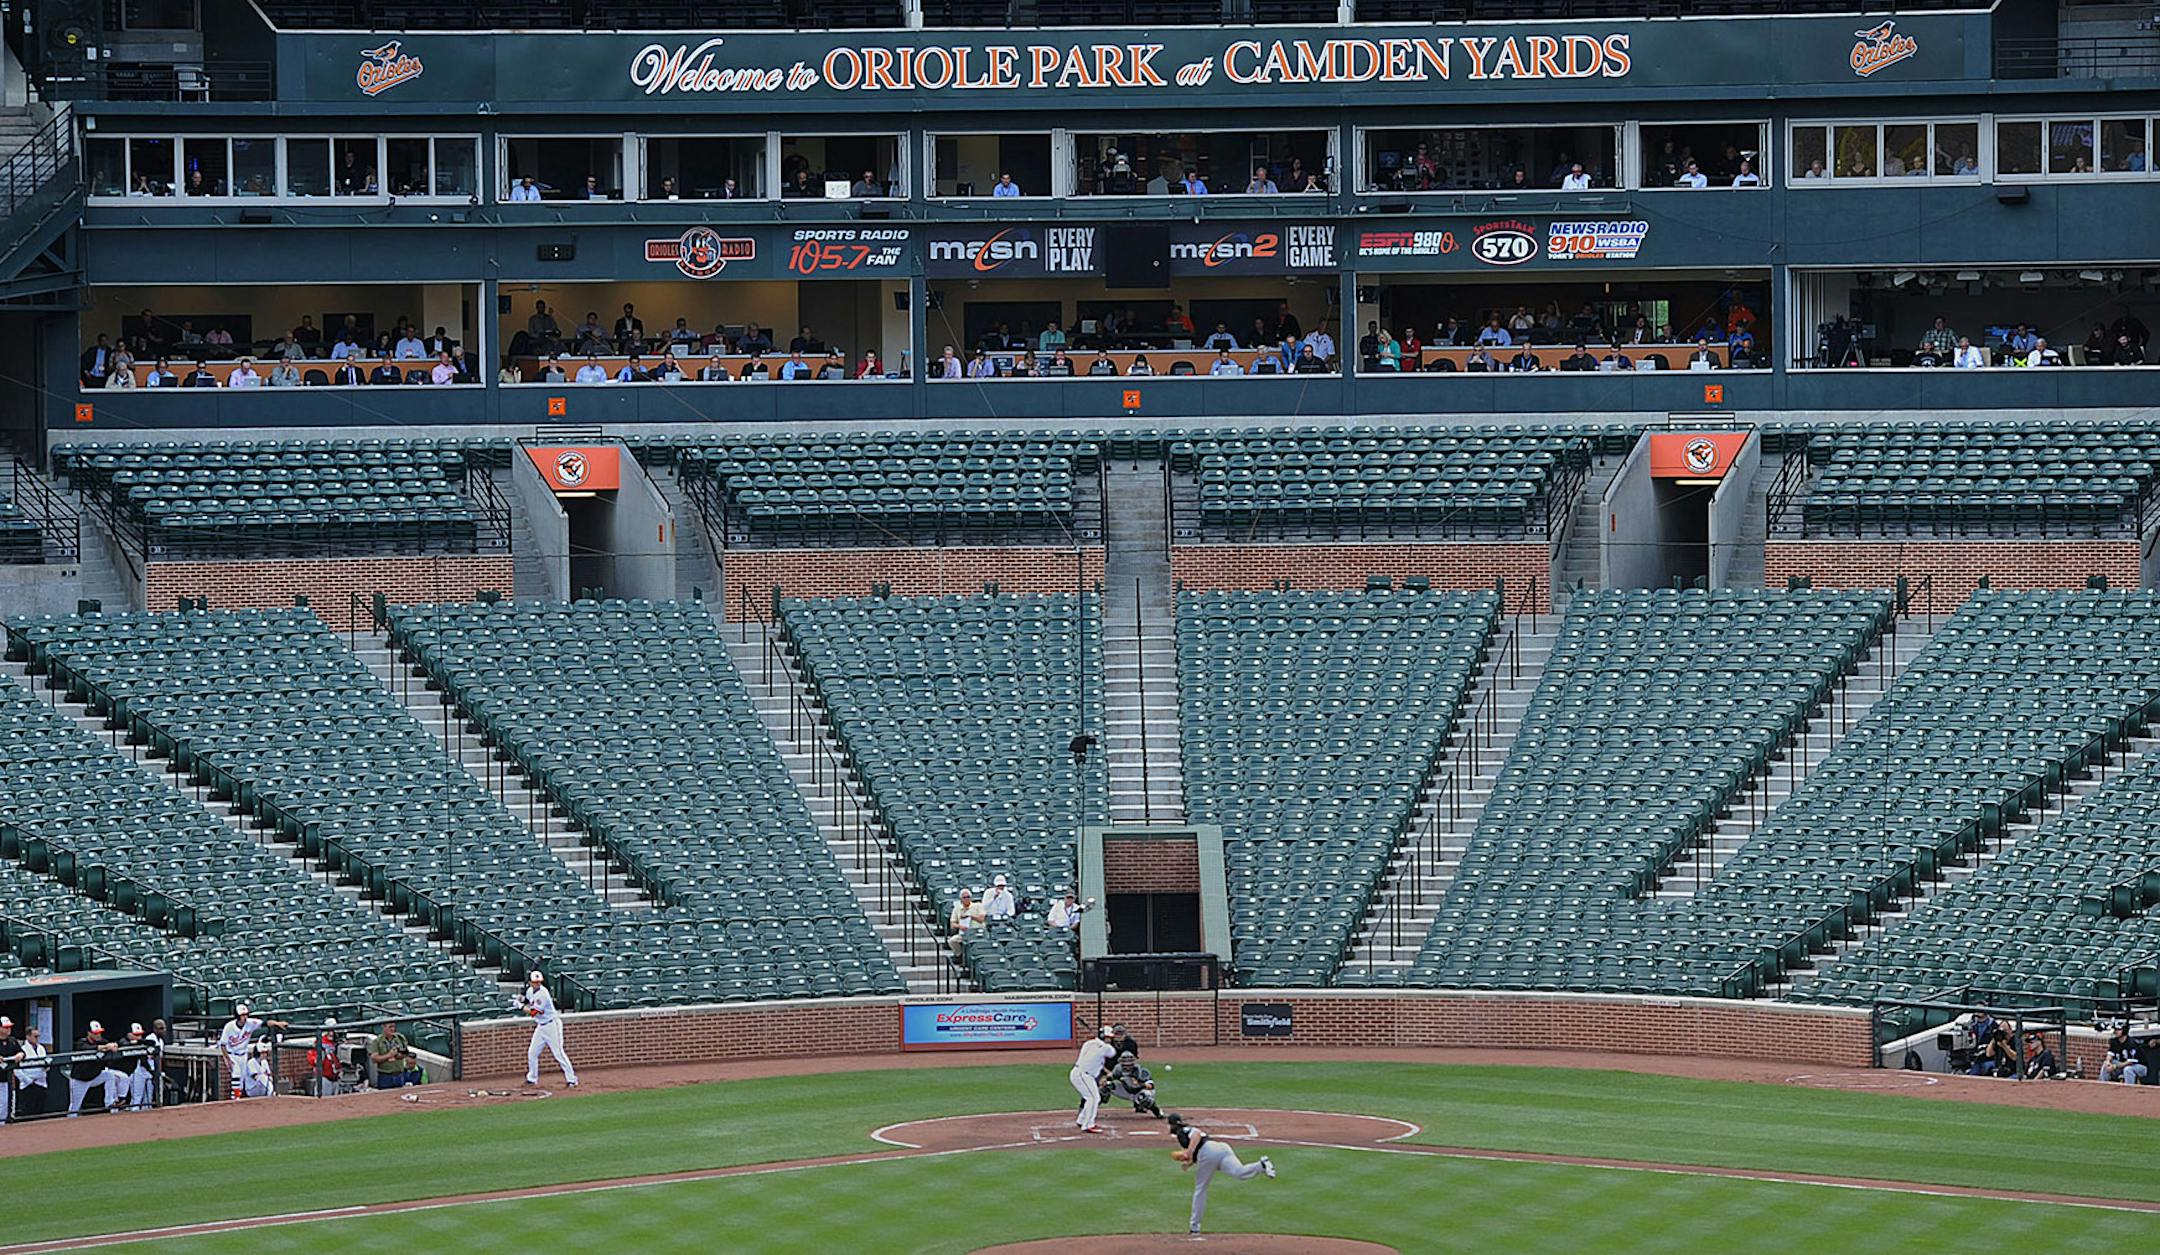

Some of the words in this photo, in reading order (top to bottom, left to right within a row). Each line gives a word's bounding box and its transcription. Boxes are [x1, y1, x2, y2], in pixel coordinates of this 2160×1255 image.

[1850, 33, 1918, 70] Orioles
[357, 54, 424, 91] Orioles
[630, 38, 784, 95] Welcome
[786, 61, 820, 91] to
[822, 45, 1020, 90] ORIOLE
[1028, 44, 1168, 87] PARK
[1175, 56, 1214, 87] at
[1223, 37, 1453, 84] CAMDEN
[1460, 34, 1631, 80] YARDS
[793, 230, 856, 241] SPORTS
[860, 229, 910, 240] RADIO
[1048, 228, 1096, 247] EVERY
[1289, 226, 1337, 246] EVERY
[1550, 222, 1648, 236] NEWSRADIO
[649, 244, 680, 257] ORIOLES
[722, 240, 751, 256] RADIO
[1360, 232, 1414, 248] ESPN
[1413, 231, 1443, 247] 980
[1481, 236, 1530, 259] 570
[1549, 235, 1596, 253] 910
[1596, 237, 1636, 248] WSBA
[788, 239, 871, 274] 105.7
[881, 246, 902, 256] THE
[929, 236, 1038, 264] masn
[1049, 247, 1095, 272] PLAY.
[1289, 244, 1338, 268] GAME.
[1391, 246, 1400, 255] OF
[866, 255, 897, 266] FAN
[936, 1013, 1027, 1024] ExpressCare
